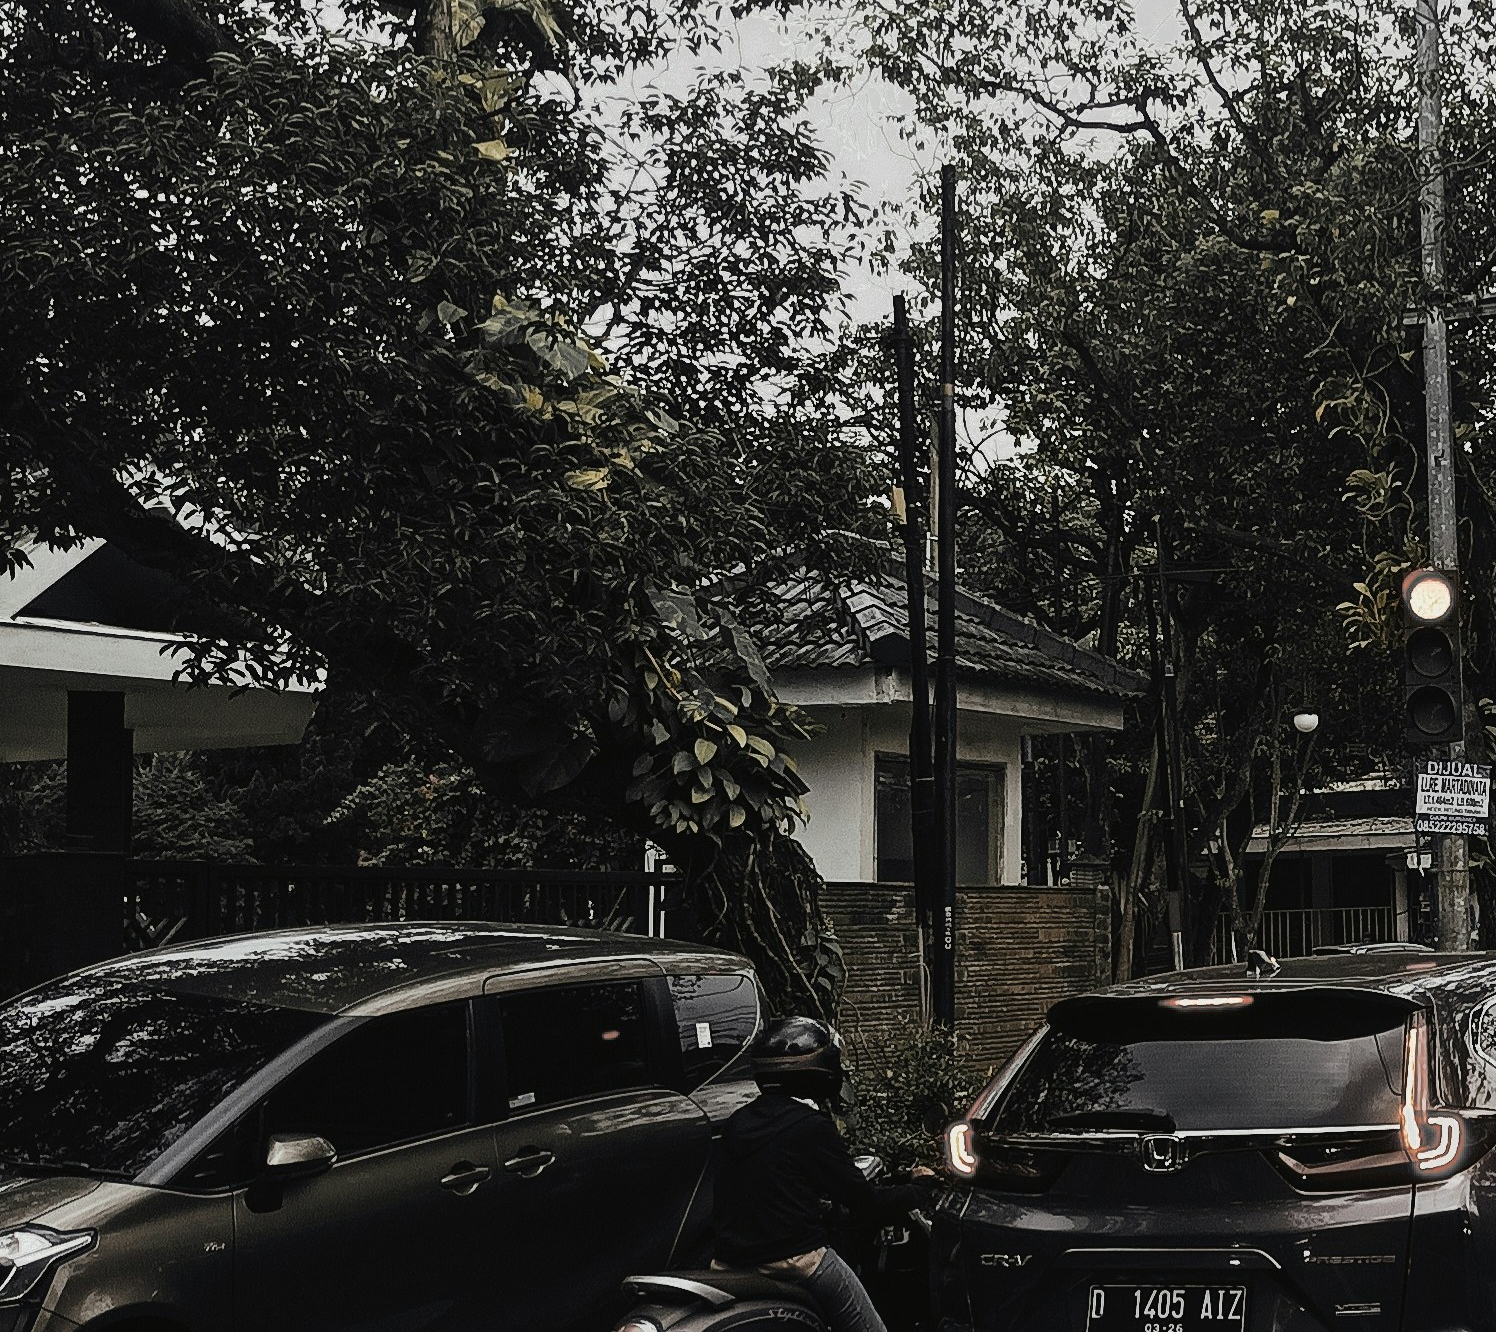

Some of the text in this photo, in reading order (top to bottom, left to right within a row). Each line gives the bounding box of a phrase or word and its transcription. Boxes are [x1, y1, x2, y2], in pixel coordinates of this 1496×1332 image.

[1428, 761, 1482, 777] DIJUAL
[981, 1254, 1032, 1267] CR-V
[1091, 1289, 1243, 1320] D 1405 AIZ
